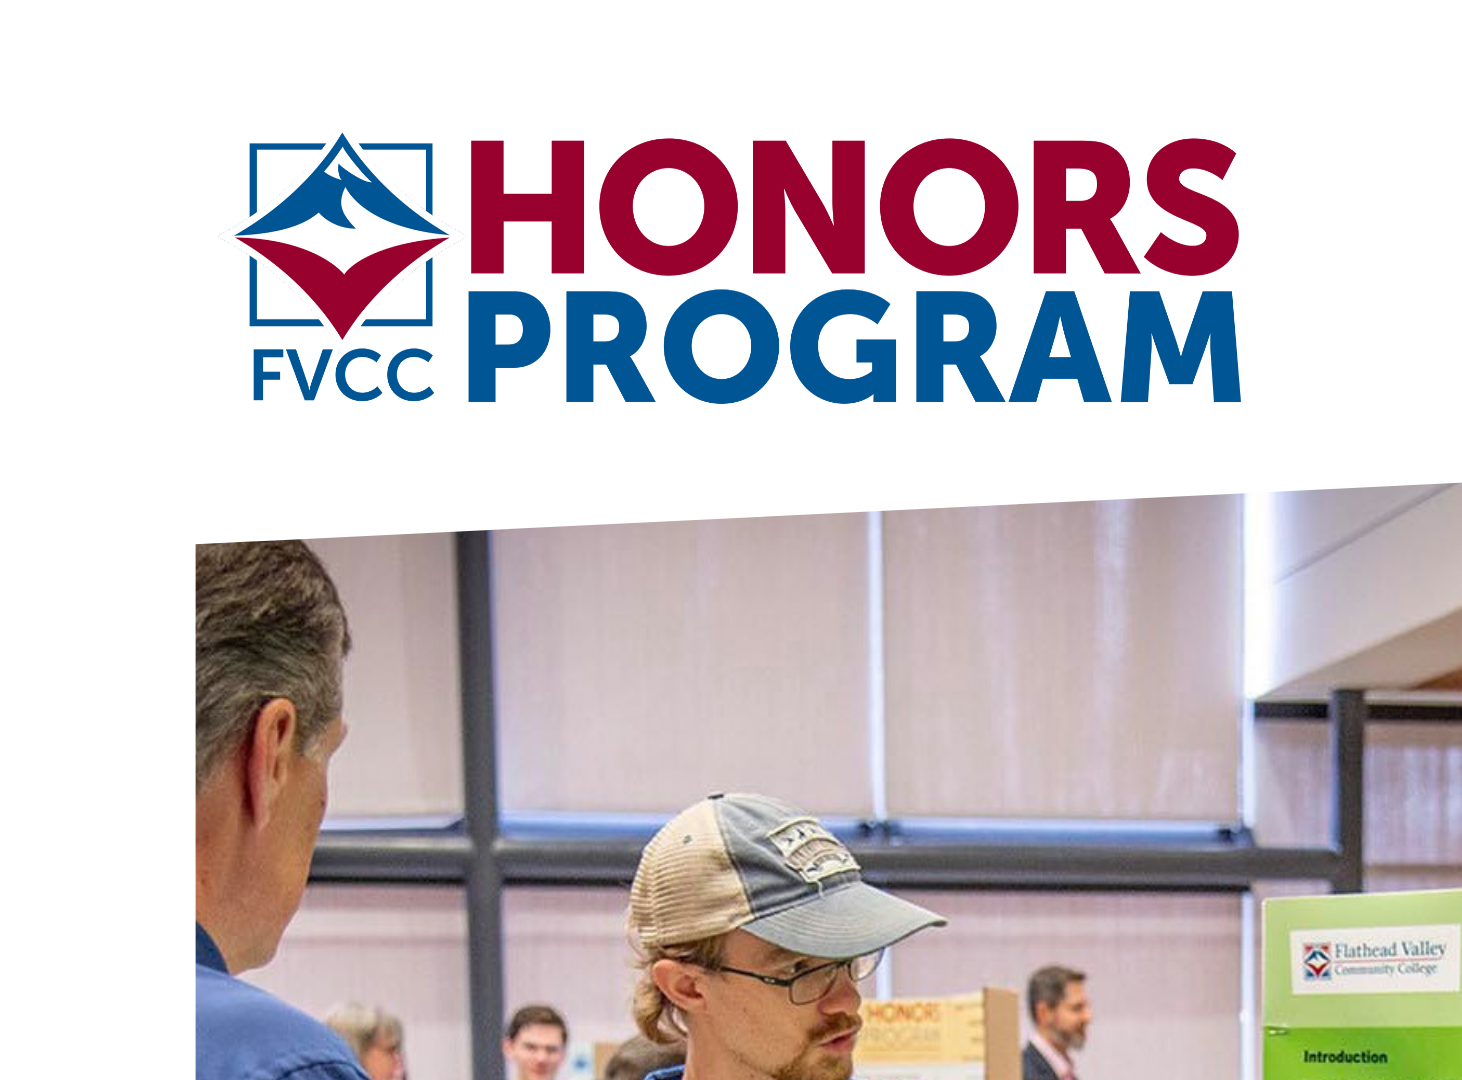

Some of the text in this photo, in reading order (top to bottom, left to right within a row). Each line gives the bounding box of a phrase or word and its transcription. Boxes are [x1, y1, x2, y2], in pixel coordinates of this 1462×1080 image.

[1335, 941, 1447, 959] Flathead Valley
[1334, 962, 1437, 977] Community College
[1304, 1050, 1388, 1064] Introduction
